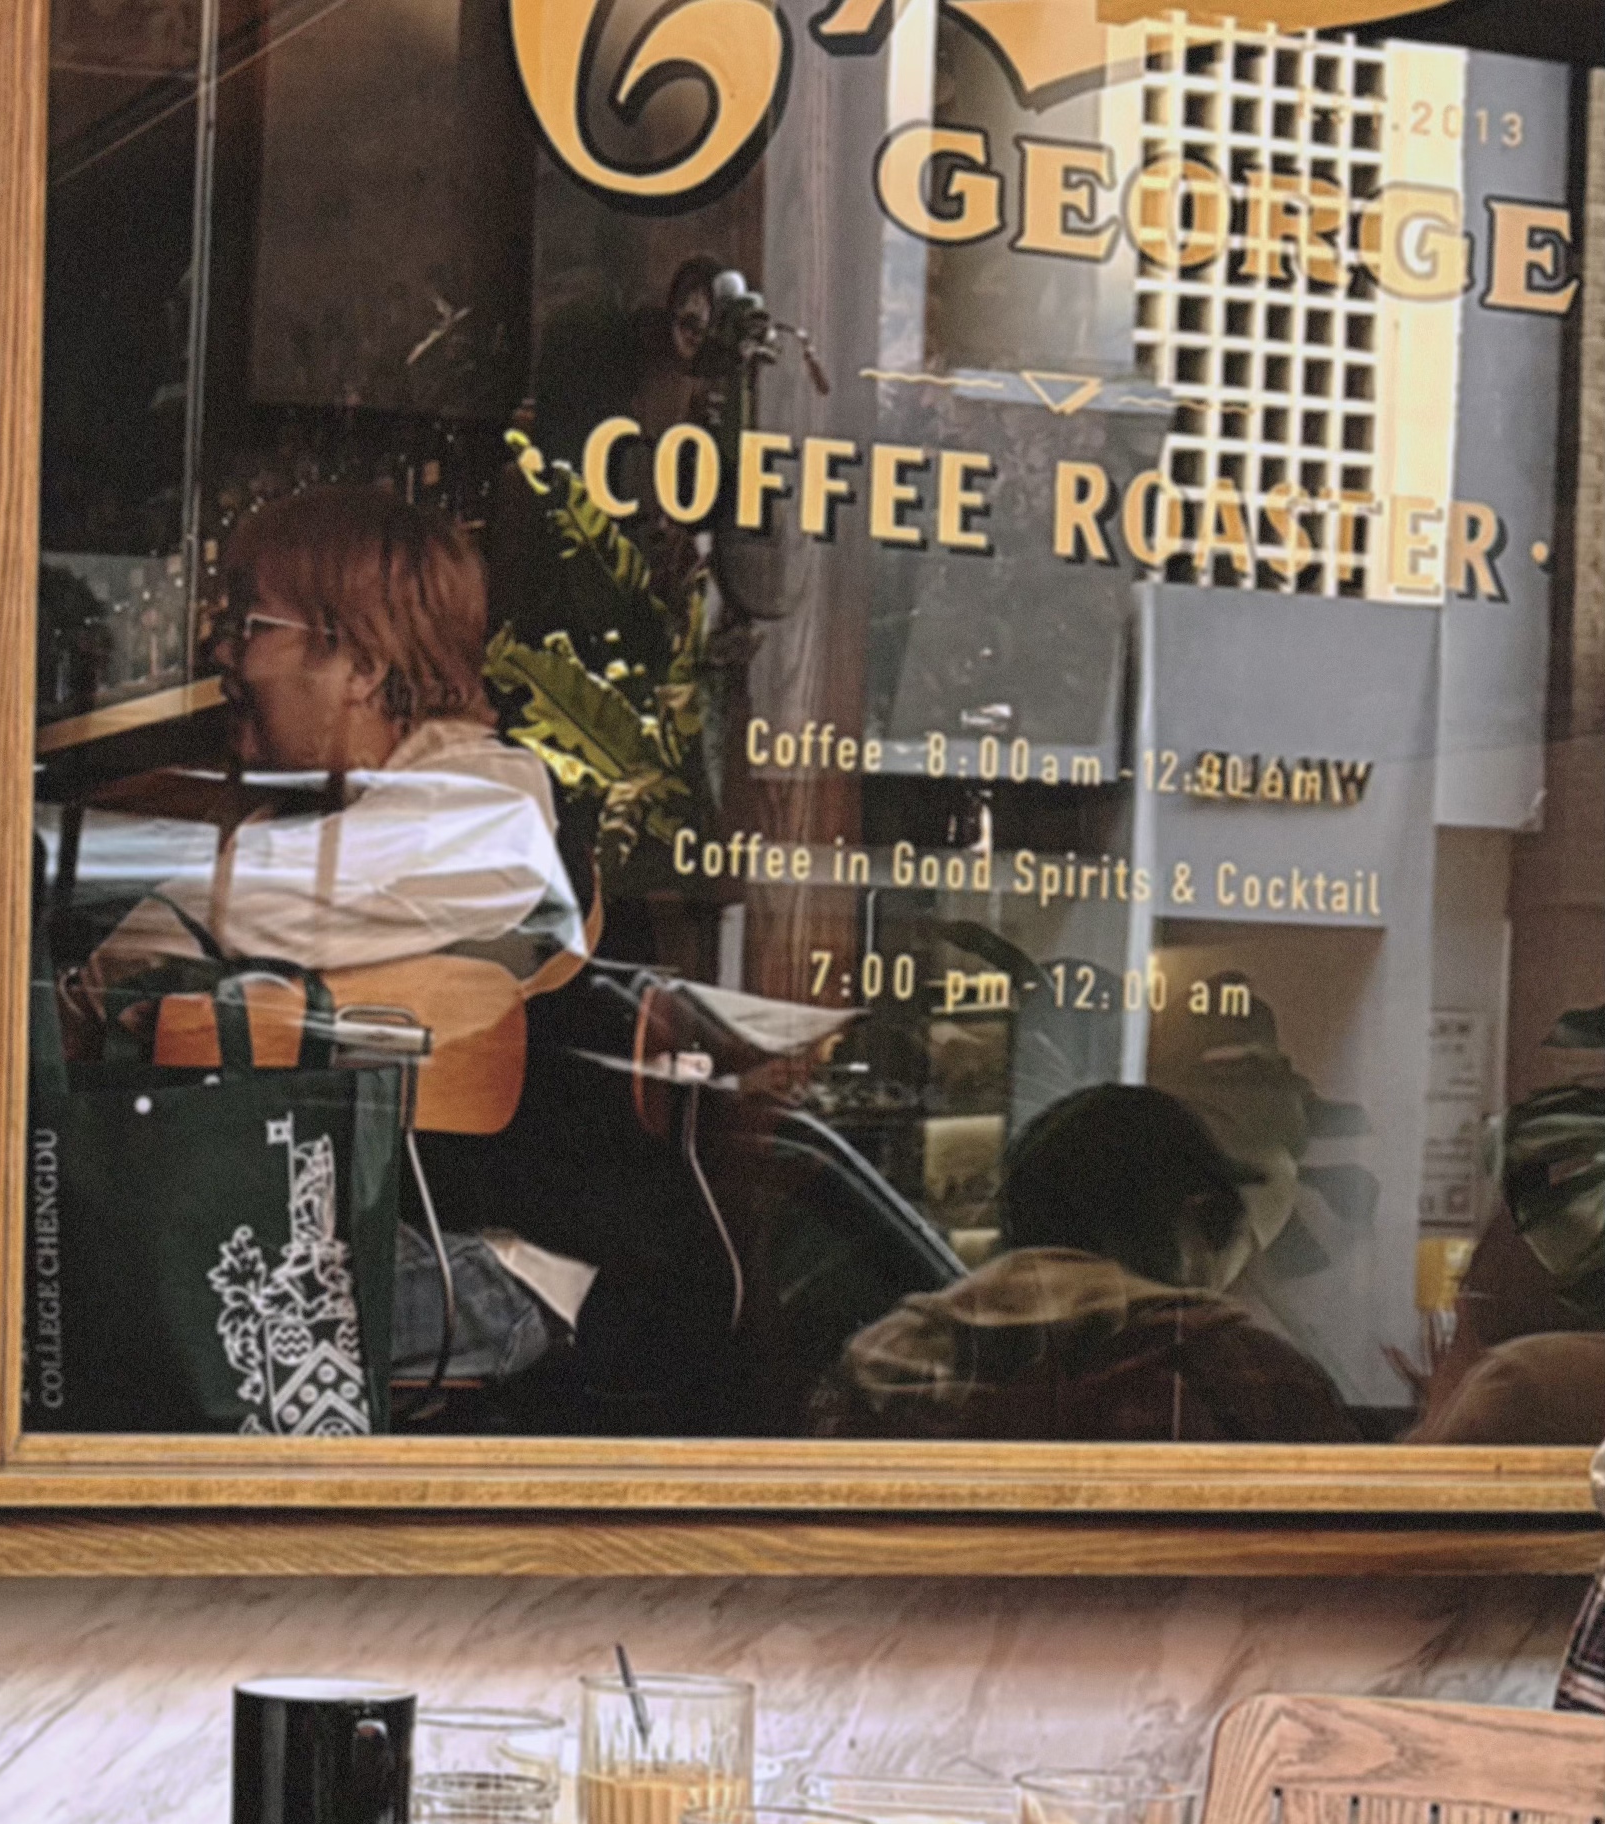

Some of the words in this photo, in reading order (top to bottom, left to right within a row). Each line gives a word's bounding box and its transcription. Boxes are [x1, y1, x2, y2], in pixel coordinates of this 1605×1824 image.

[875, 122, 1583, 315] GEORGE
[582, 415, 995, 556] COFFEE
[1054, 460, 1509, 602] ROASTER
[747, 718, 883, 772] Coffee
[673, 828, 812, 878] Coffee
[833, 836, 880, 884] in
[893, 840, 991, 891] Good
[1012, 850, 1152, 907] Spirits
[1170, 861, 1195, 904] &
[1216, 861, 1381, 915] Cocktail
[810, 951, 915, 1000] 7:00
[1188, 978, 1251, 1017] am
